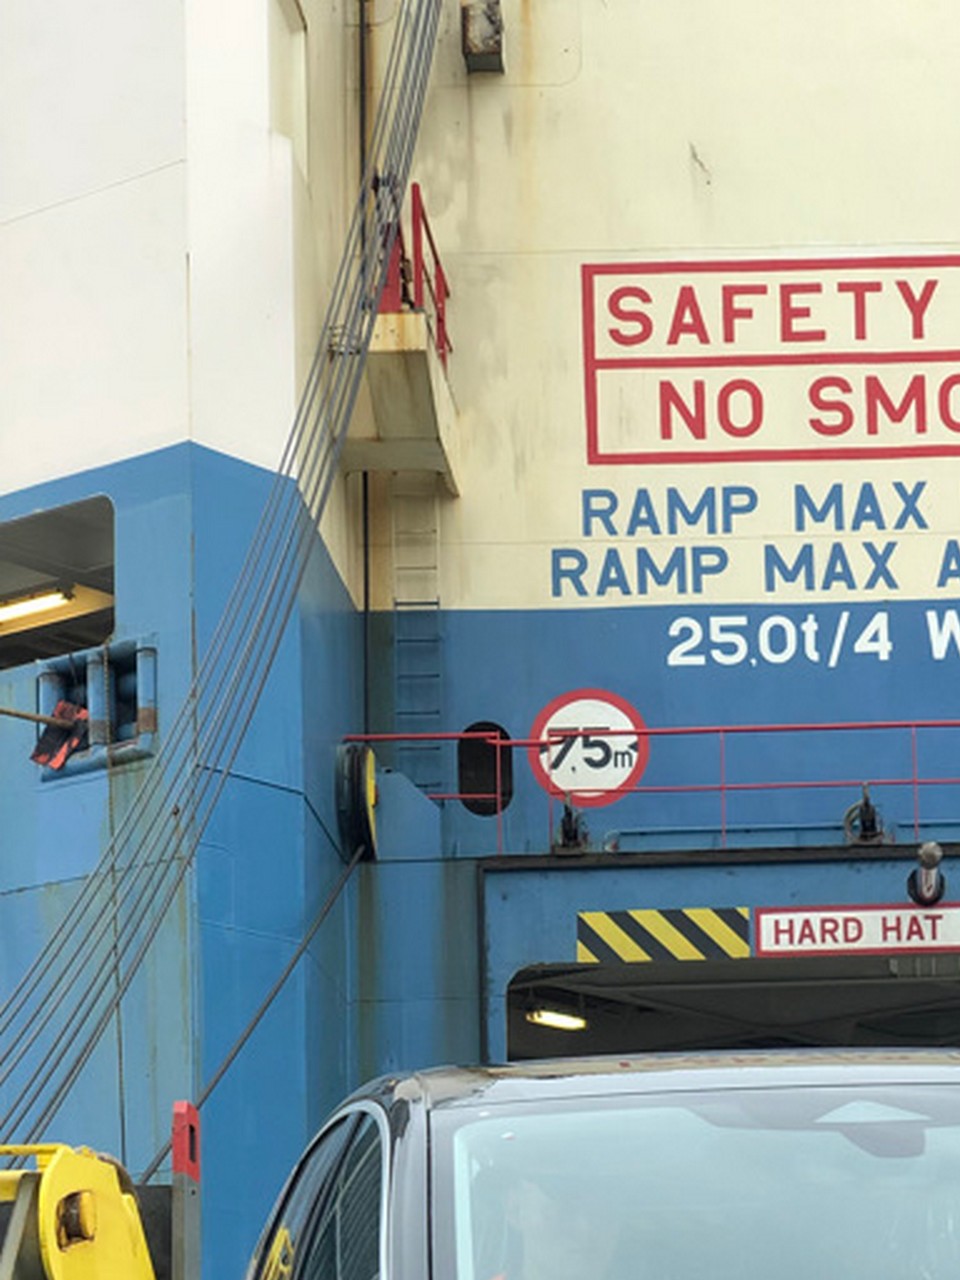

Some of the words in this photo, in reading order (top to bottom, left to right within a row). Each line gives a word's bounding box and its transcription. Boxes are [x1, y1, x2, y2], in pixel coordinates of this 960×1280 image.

[608, 281, 936, 345] SAFETY
[660, 379, 763, 439] NO
[584, 487, 757, 535] RAMP
[796, 483, 926, 530] MAX
[552, 547, 728, 596] RAMP
[765, 543, 897, 591] MAX
[773, 917, 863, 945] HARD
[881, 914, 943, 942] HAT
